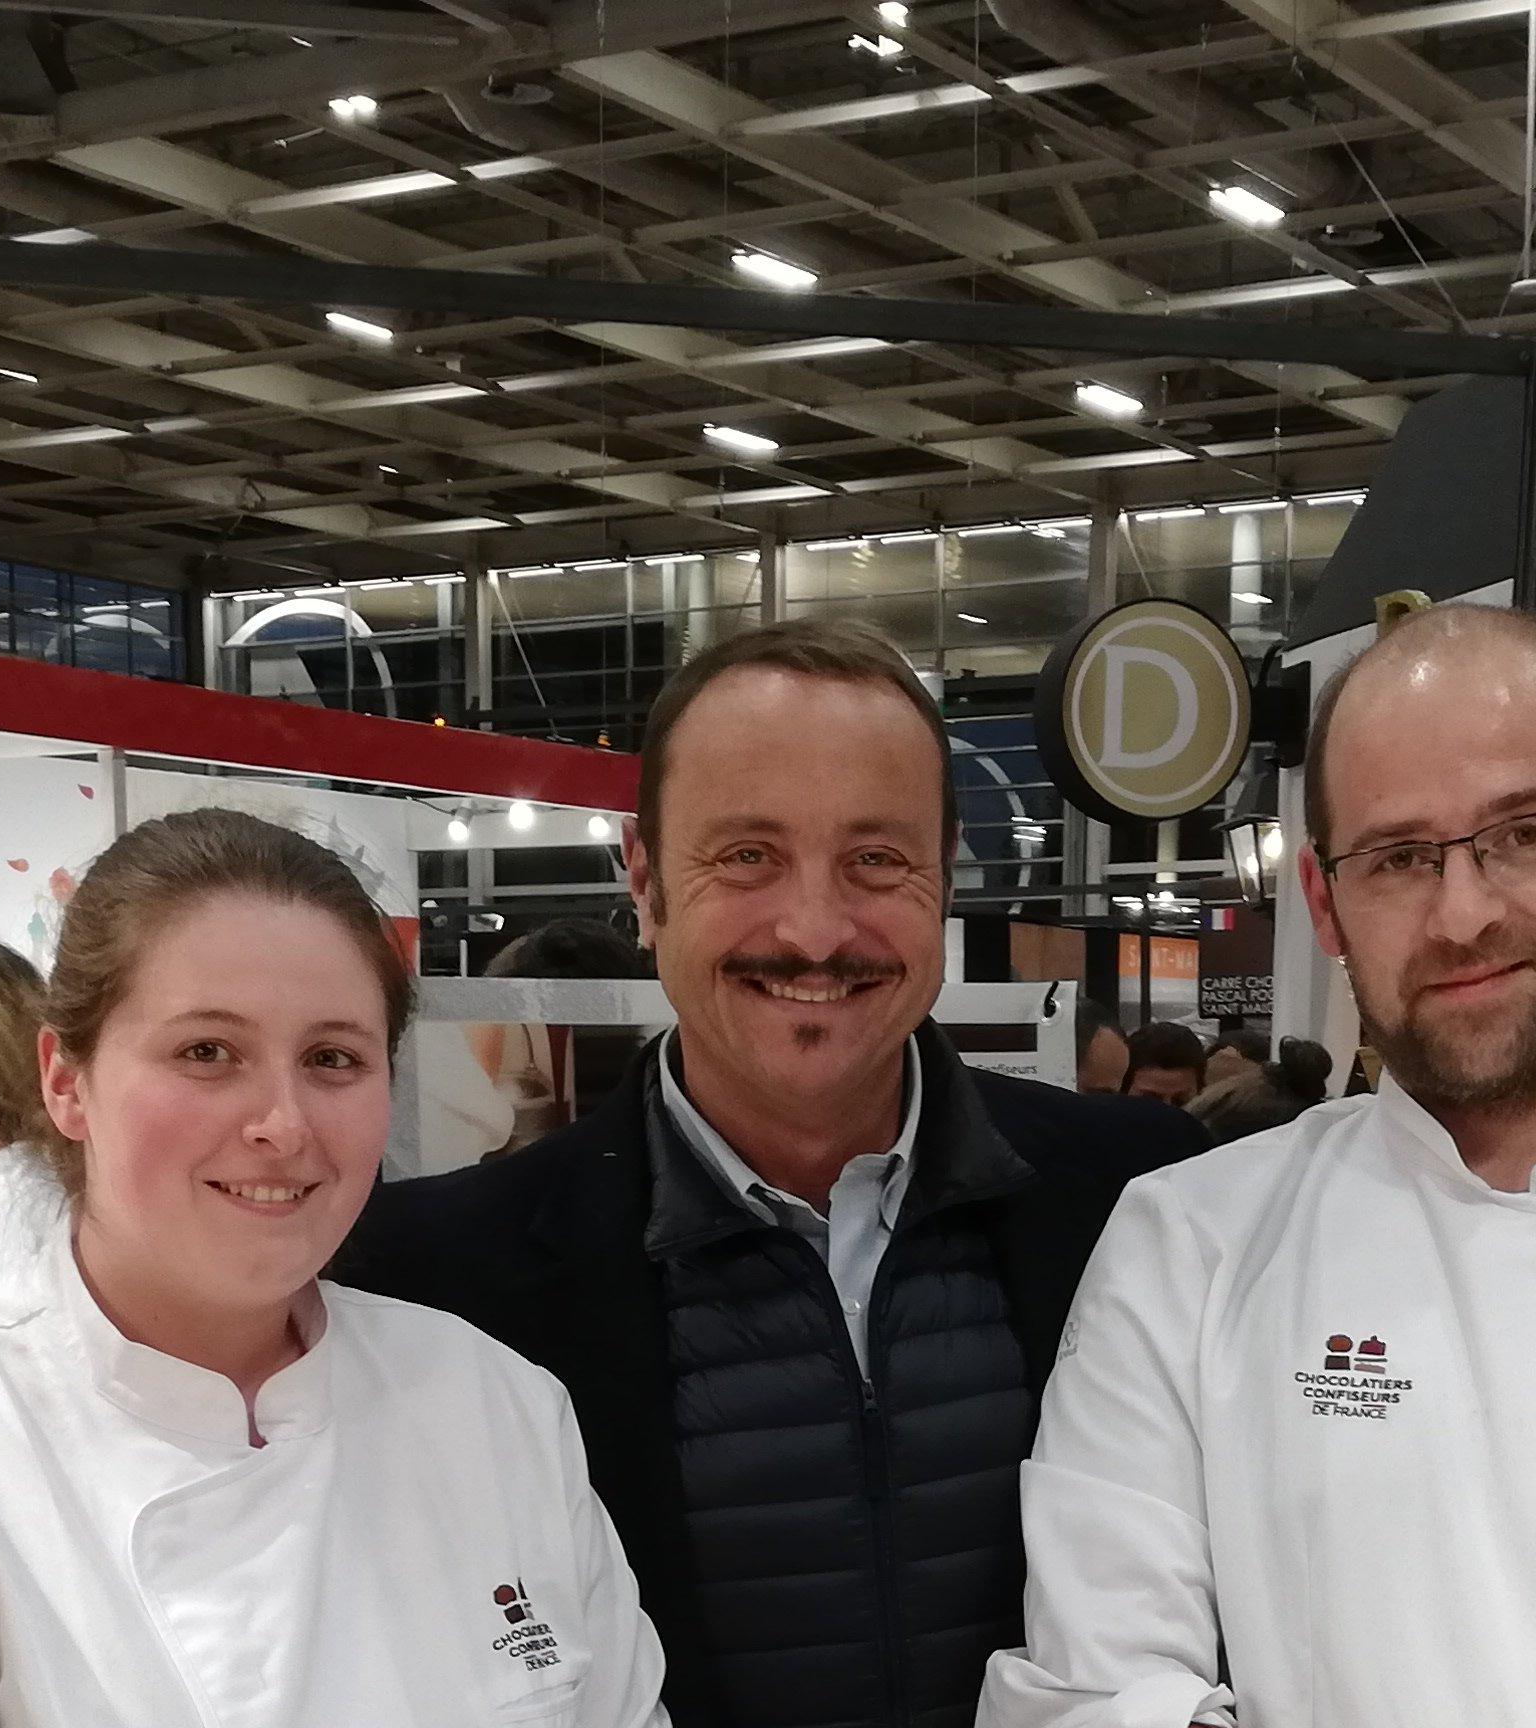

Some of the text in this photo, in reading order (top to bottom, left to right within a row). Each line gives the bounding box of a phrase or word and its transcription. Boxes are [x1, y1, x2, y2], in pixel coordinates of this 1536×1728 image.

[1098, 643, 1200, 769] D
[1294, 1371, 1413, 1390] CHOCOLATIERS
[1303, 1387, 1401, 1404] CONFISEURS
[1312, 1404, 1387, 1420] DE FRANCE
